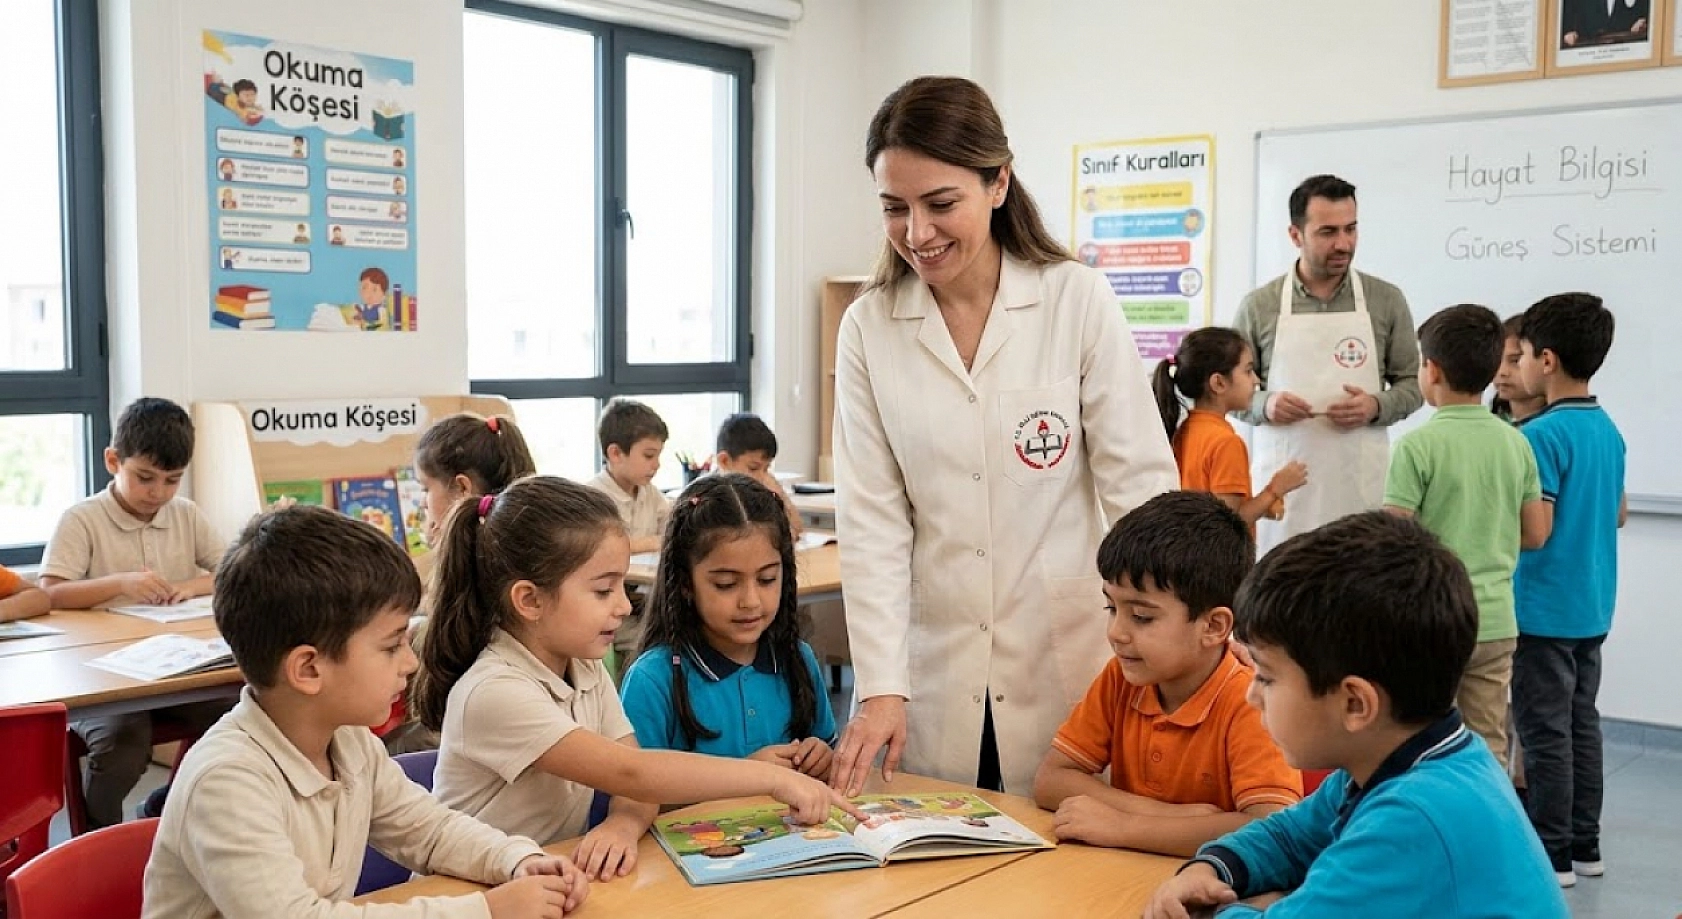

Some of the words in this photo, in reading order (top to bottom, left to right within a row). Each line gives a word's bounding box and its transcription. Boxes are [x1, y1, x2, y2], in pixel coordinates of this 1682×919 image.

[264, 50, 362, 89] Okuma
[270, 83, 359, 122] Köşesi
[1082, 154, 1121, 175] Sınıf
[1126, 150, 1205, 171] Kuralları
[1448, 151, 1536, 205] Hayat
[1559, 145, 1648, 199] Bilgisi
[1445, 226, 1529, 261] Güneş
[1551, 224, 1656, 257] Sistemi
[251, 408, 337, 431] Okuma
[346, 403, 417, 432] Köşesi
